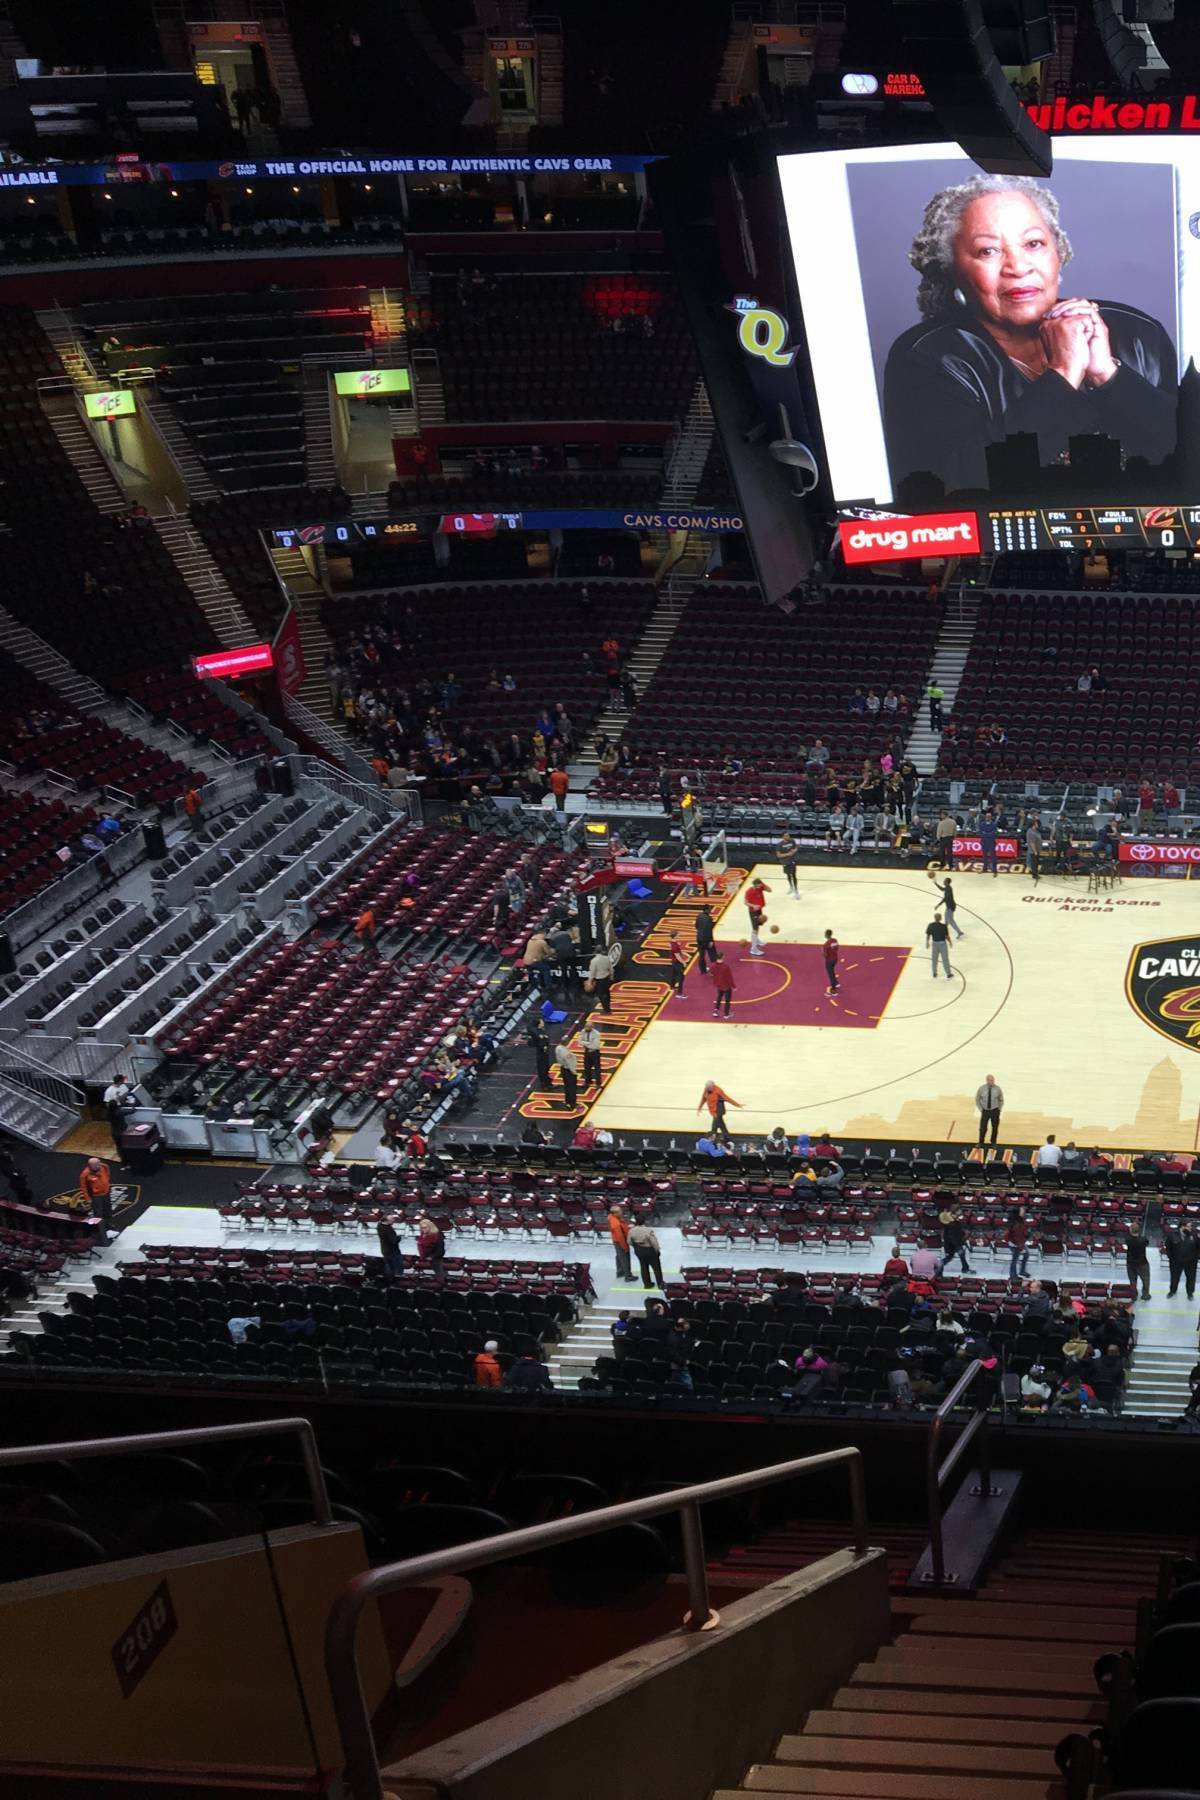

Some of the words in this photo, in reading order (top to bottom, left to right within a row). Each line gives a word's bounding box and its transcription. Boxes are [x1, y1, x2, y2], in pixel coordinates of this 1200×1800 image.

[887, 74, 908, 84] CAR
[1026, 96, 1171, 130] uicken
[266, 163, 296, 175] THE
[299, 160, 367, 174] OFFICIAL
[370, 159, 415, 172] HOME
[418, 159, 448, 171] FOR
[451, 158, 531, 171] AUTHENTIC
[534, 157, 570, 170] CAVS
[573, 157, 613, 170] GEAR
[735, 298, 758, 309] The
[736, 309, 795, 365] Q
[454, 517, 465, 531] 0
[508, 518, 516, 529] 0
[624, 514, 743, 530] CAVS.COM/SHO
[336, 527, 348, 540] 0
[384, 523, 418, 534] 44:22
[1080, 525, 1086, 533] 0
[283, 536, 292, 547] 0
[849, 530, 908, 549] drug
[912, 522, 972, 543] mart
[1161, 530, 1174, 546] 0
[964, 841, 1015, 852] TOTA
[1021, 895, 1099, 905] Quicken
[1104, 897, 1161, 907] Loans
[1058, 904, 1114, 913] Arena
